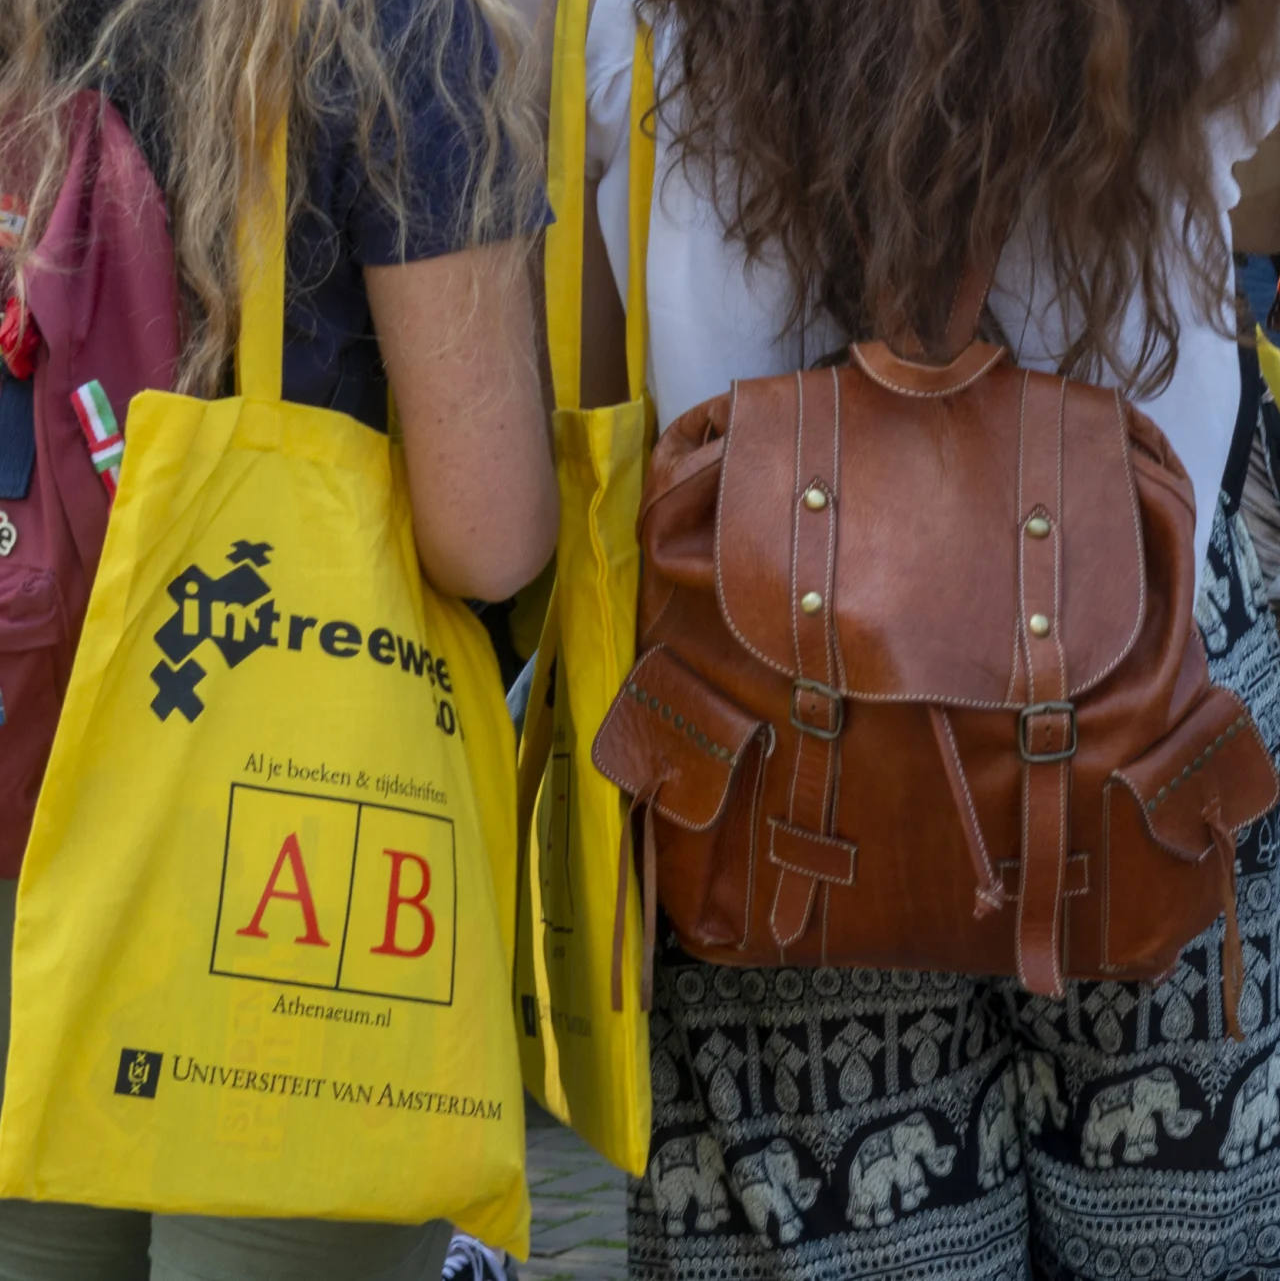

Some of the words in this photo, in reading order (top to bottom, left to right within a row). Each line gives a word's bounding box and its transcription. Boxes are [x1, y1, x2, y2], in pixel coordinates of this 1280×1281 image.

[243, 752, 264, 774] Al
[266, 755, 283, 782] je
[287, 757, 352, 787] boeken
[355, 770, 371, 791] &
[375, 773, 448, 806] tijdschriften
[235, 830, 331, 949] A
[369, 847, 436, 960] B
[271, 993, 393, 1028] Athenaeum.nl
